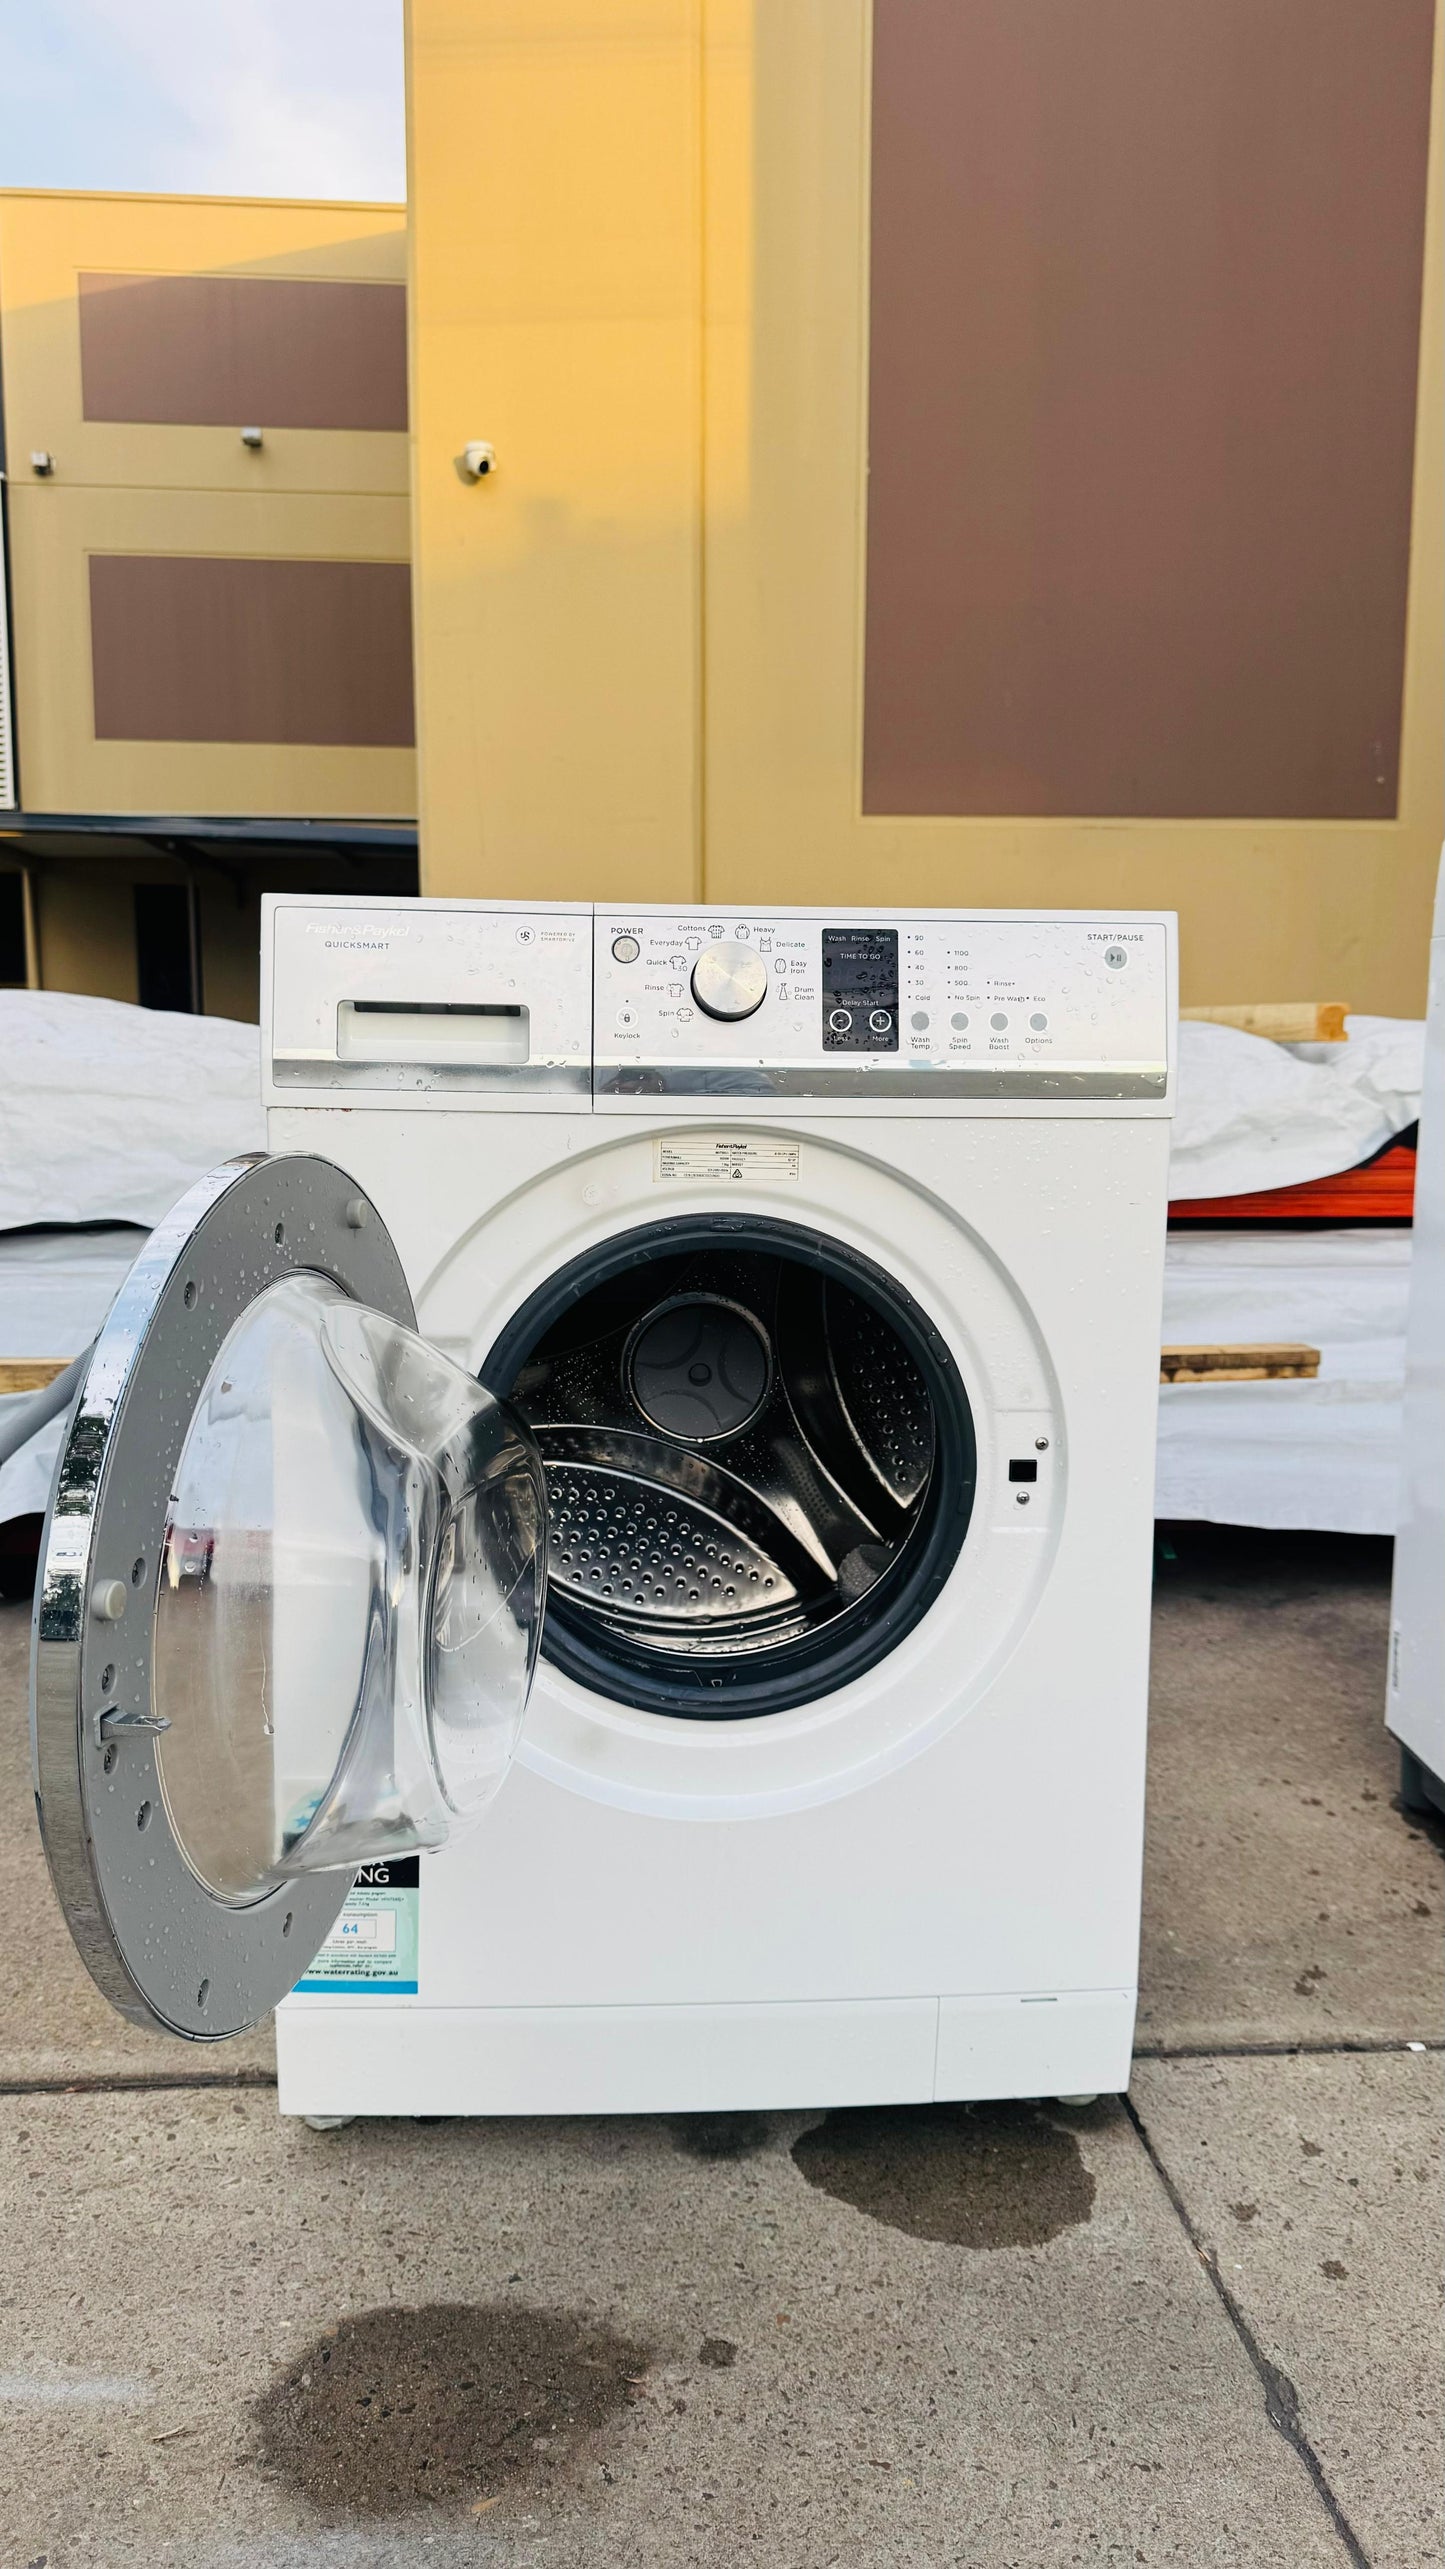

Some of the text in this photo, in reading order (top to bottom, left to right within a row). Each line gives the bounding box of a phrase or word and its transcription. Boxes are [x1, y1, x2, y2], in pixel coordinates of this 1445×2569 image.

[610, 927, 644, 935] POWER
[677, 925, 706, 933] Cottons
[753, 926, 776, 934] Heavy
[875, 935, 891, 943] Spin
[1087, 933, 1144, 942] START/PAUSE
[325, 940, 390, 950] QUICKSMART
[649, 939, 684, 948] Everyday
[646, 958, 668, 967] Quick
[790, 960, 808, 969] Easy
[644, 984, 665, 992] Rinse
[658, 1009, 675, 1018] Spin
[614, 1032, 641, 1041] Keylock
[952, 1036, 968, 1044] Spin
[1024, 1037, 1053, 1045] Options
[342, 1923, 358, 1934] 64
